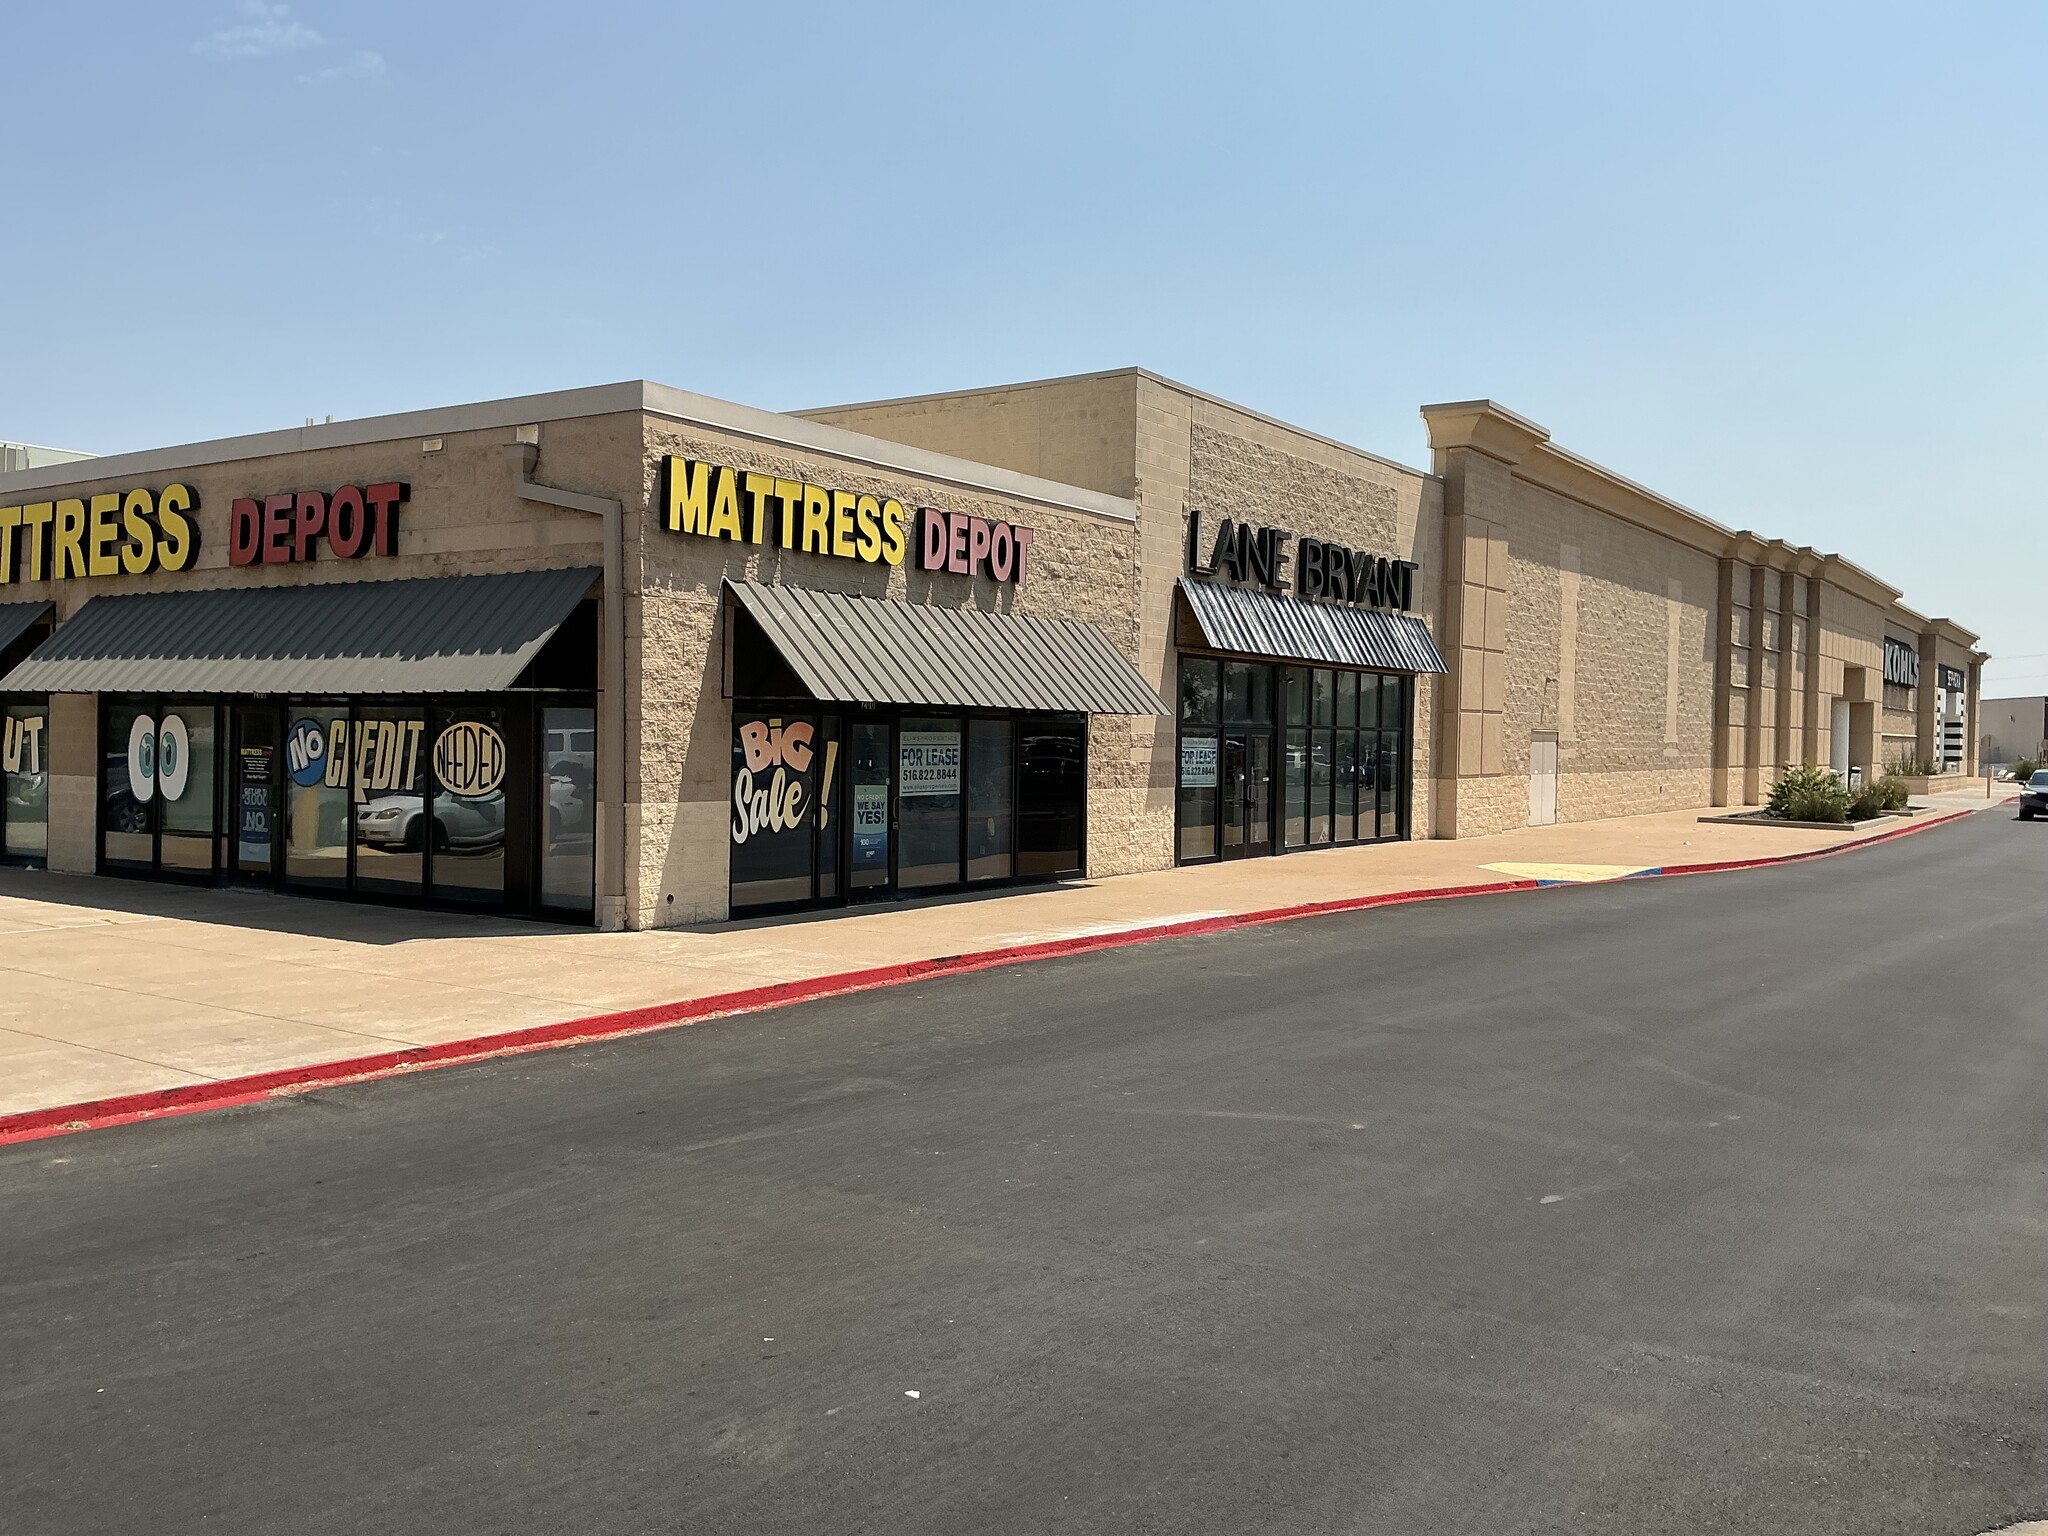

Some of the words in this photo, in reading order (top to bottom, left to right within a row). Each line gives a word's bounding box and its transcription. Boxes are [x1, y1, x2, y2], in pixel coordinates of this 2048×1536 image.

[229, 482, 402, 566] DEPOT
[661, 455, 905, 566] MATTRESS
[916, 507, 1034, 584] DEPOT
[1189, 510, 1292, 590] LANE
[1298, 537, 1419, 611] BRYANT
[1883, 643, 1920, 688] KOHL'S
[3, 715, 43, 775] UT
[289, 727, 323, 774] NO
[325, 719, 425, 803] CREDIT
[436, 725, 503, 790] NEEDED
[902, 749, 922, 767] FOR
[926, 748, 958, 766] LEASE
[1180, 750, 1195, 765] FOR
[1196, 750, 1216, 765] LEASE
[903, 769, 957, 781] 516.822.8844
[245, 811, 265, 829] NO
[857, 801, 869, 810] WE
[871, 801, 885, 810] SAY
[857, 810, 885, 825] YES!
